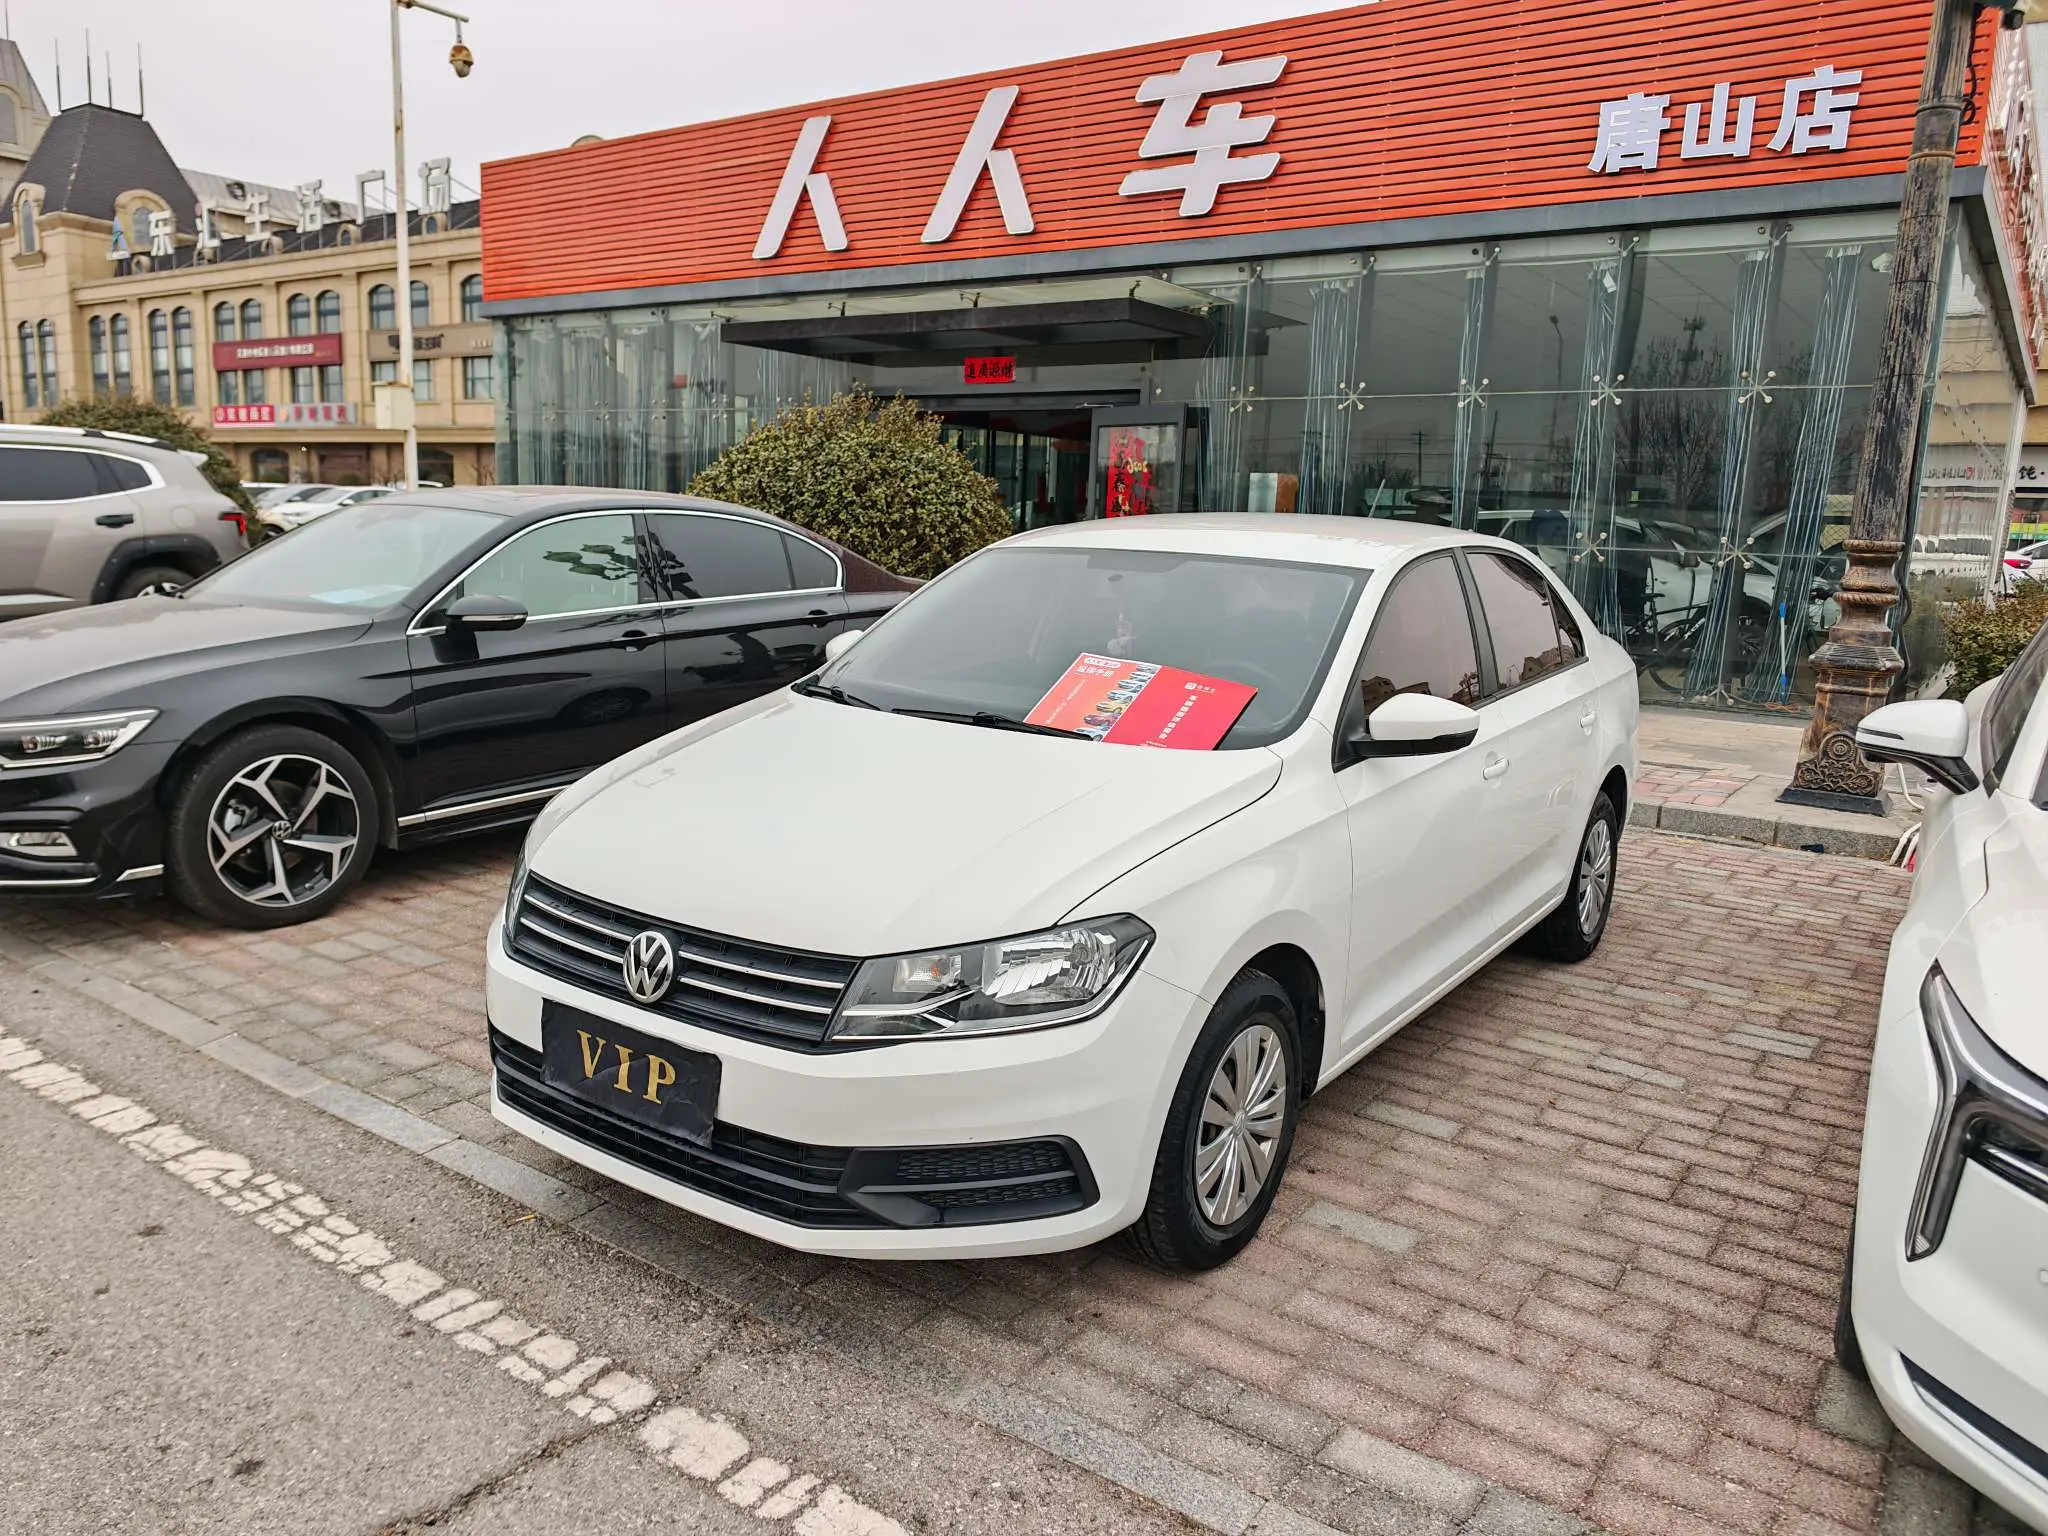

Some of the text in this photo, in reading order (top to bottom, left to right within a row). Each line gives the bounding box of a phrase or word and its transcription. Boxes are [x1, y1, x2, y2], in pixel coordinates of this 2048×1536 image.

[754, 51, 1288, 258] 人人车
[1588, 65, 1862, 173] 唐山店
[577, 1030, 676, 1104] VIP
